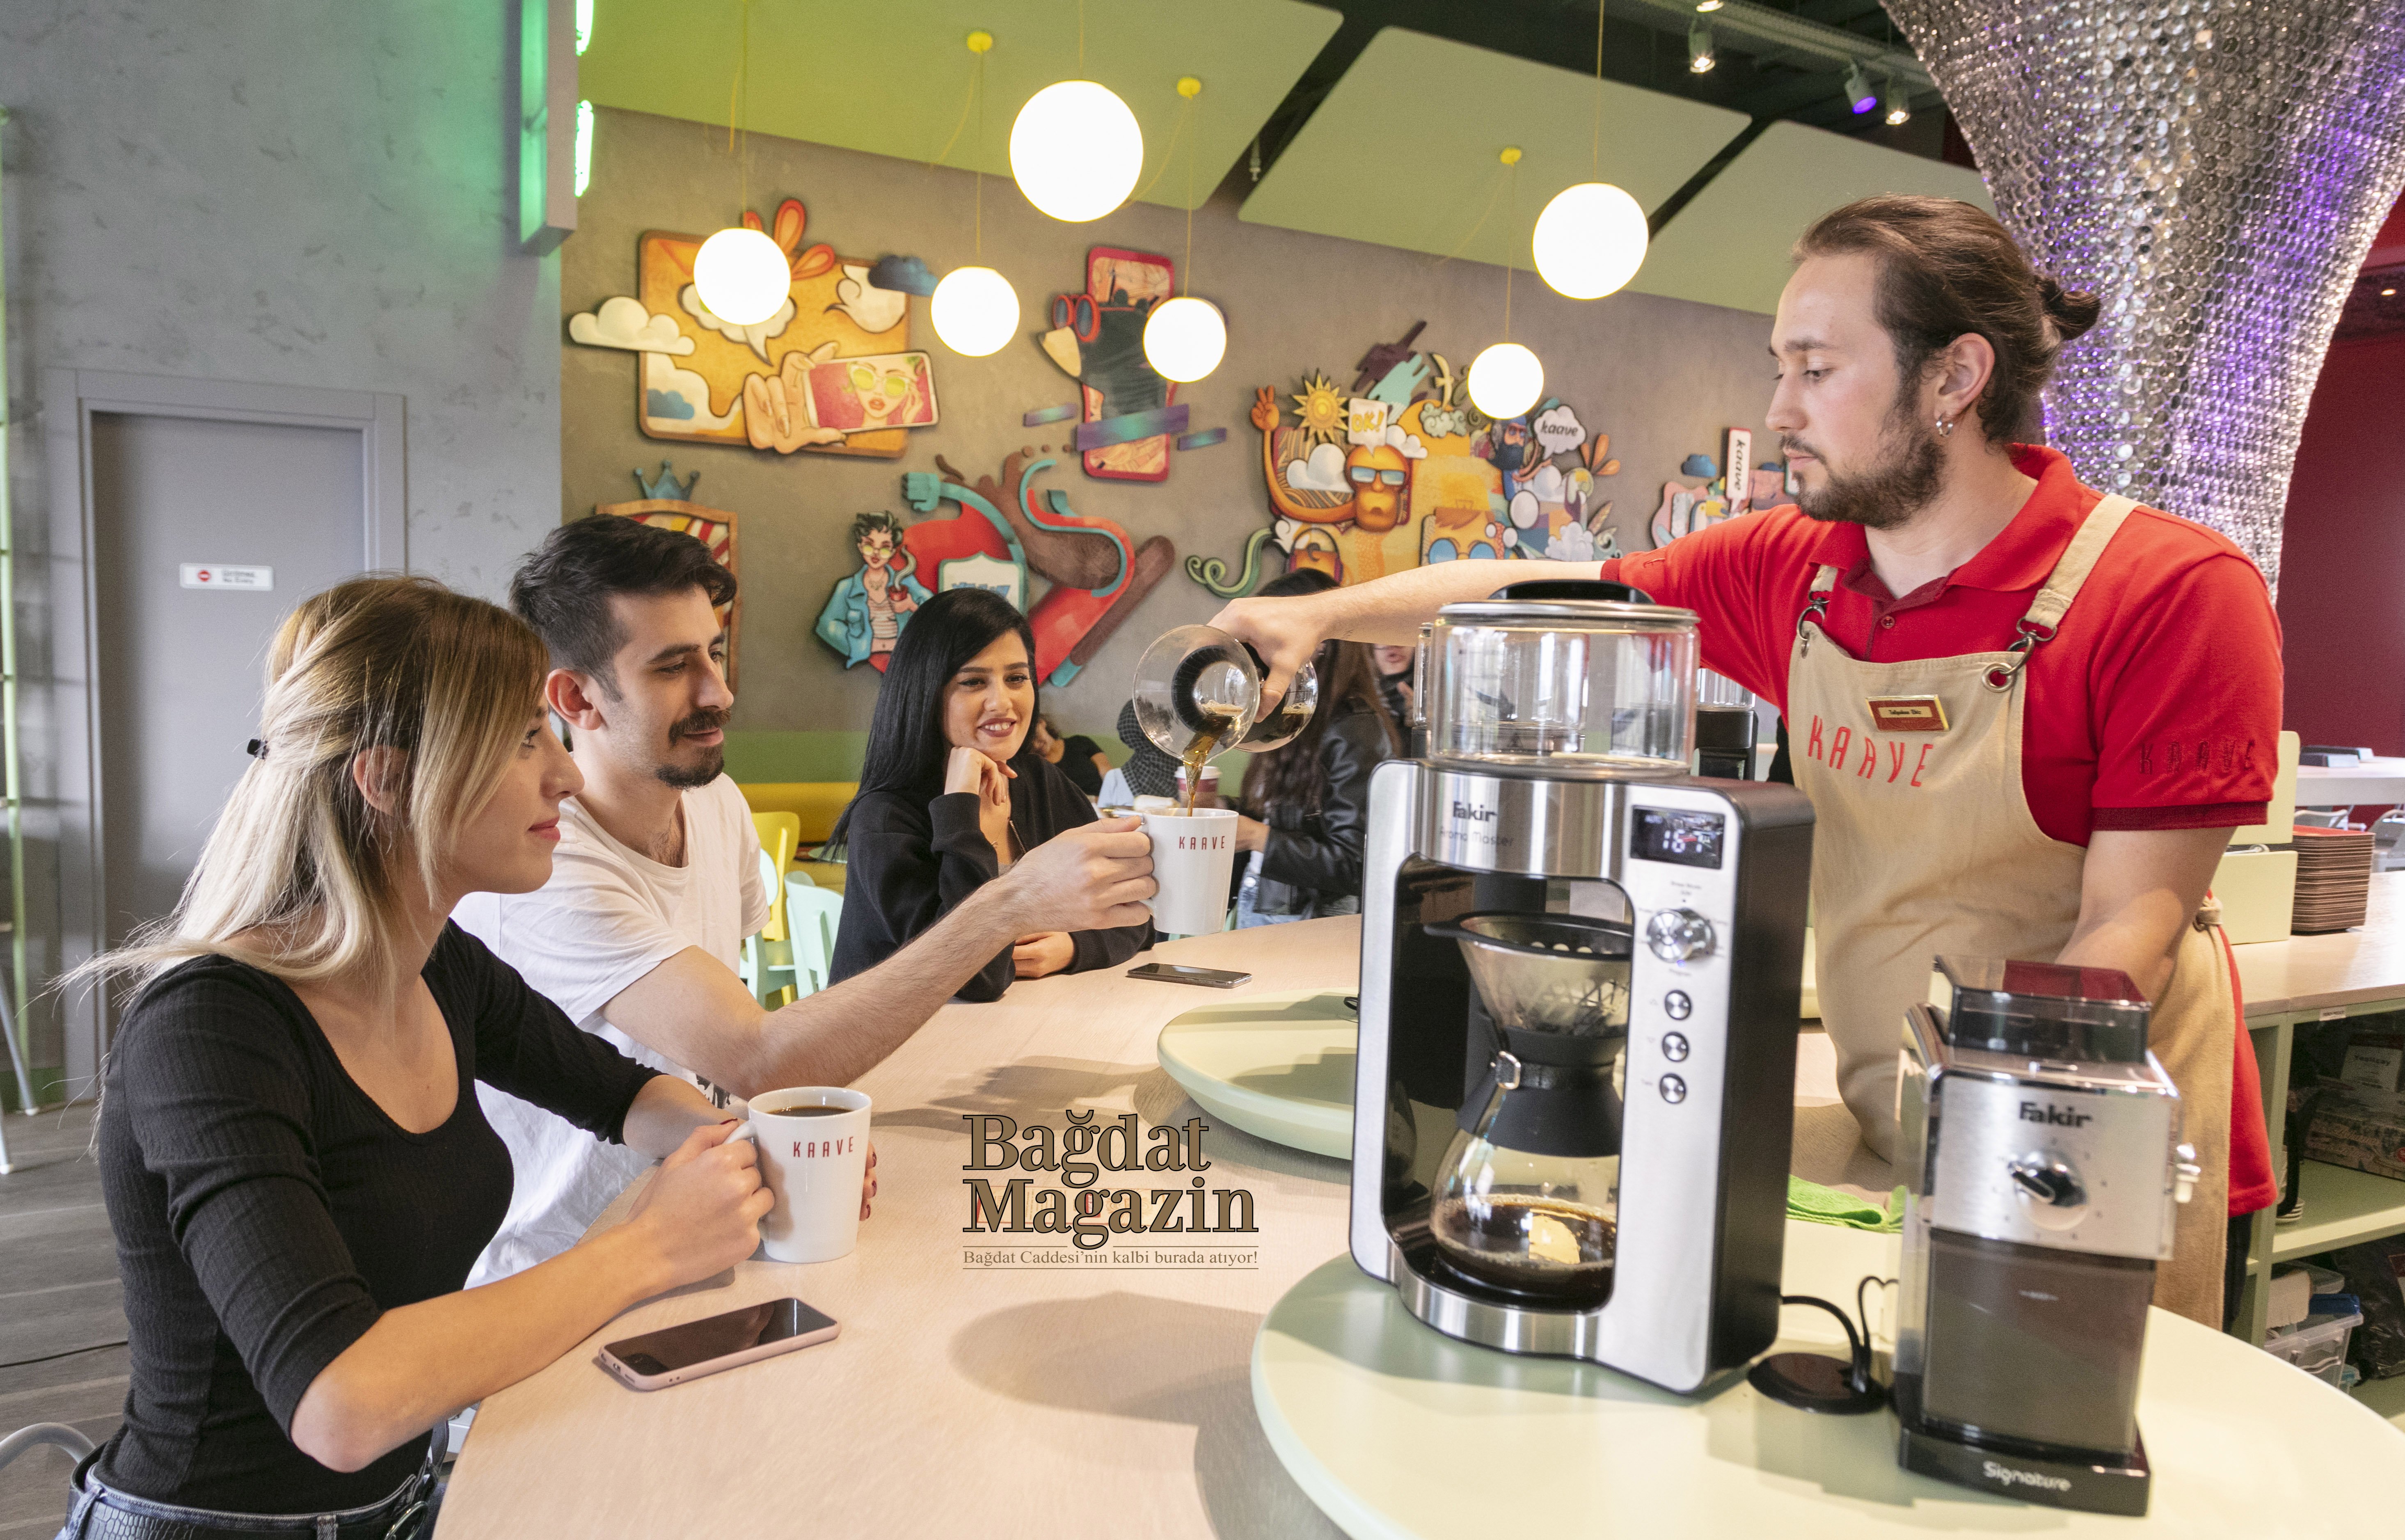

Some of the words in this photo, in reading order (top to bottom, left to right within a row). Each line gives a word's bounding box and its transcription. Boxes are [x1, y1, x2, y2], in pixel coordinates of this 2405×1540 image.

[1351, 410, 1384, 433] OK!
[1541, 420, 1579, 437] kaave
[1735, 439, 1746, 490] kaave
[1808, 715, 1934, 787] KAAVE
[2139, 739, 2255, 776] KAAVE
[1453, 801, 1497, 821] Fakir
[1178, 835, 1225, 850] KAAVE
[2019, 1101, 2092, 1128] Fakir
[793, 1136, 854, 1158] KAAVE
[1983, 1461, 2072, 1492] Signature
